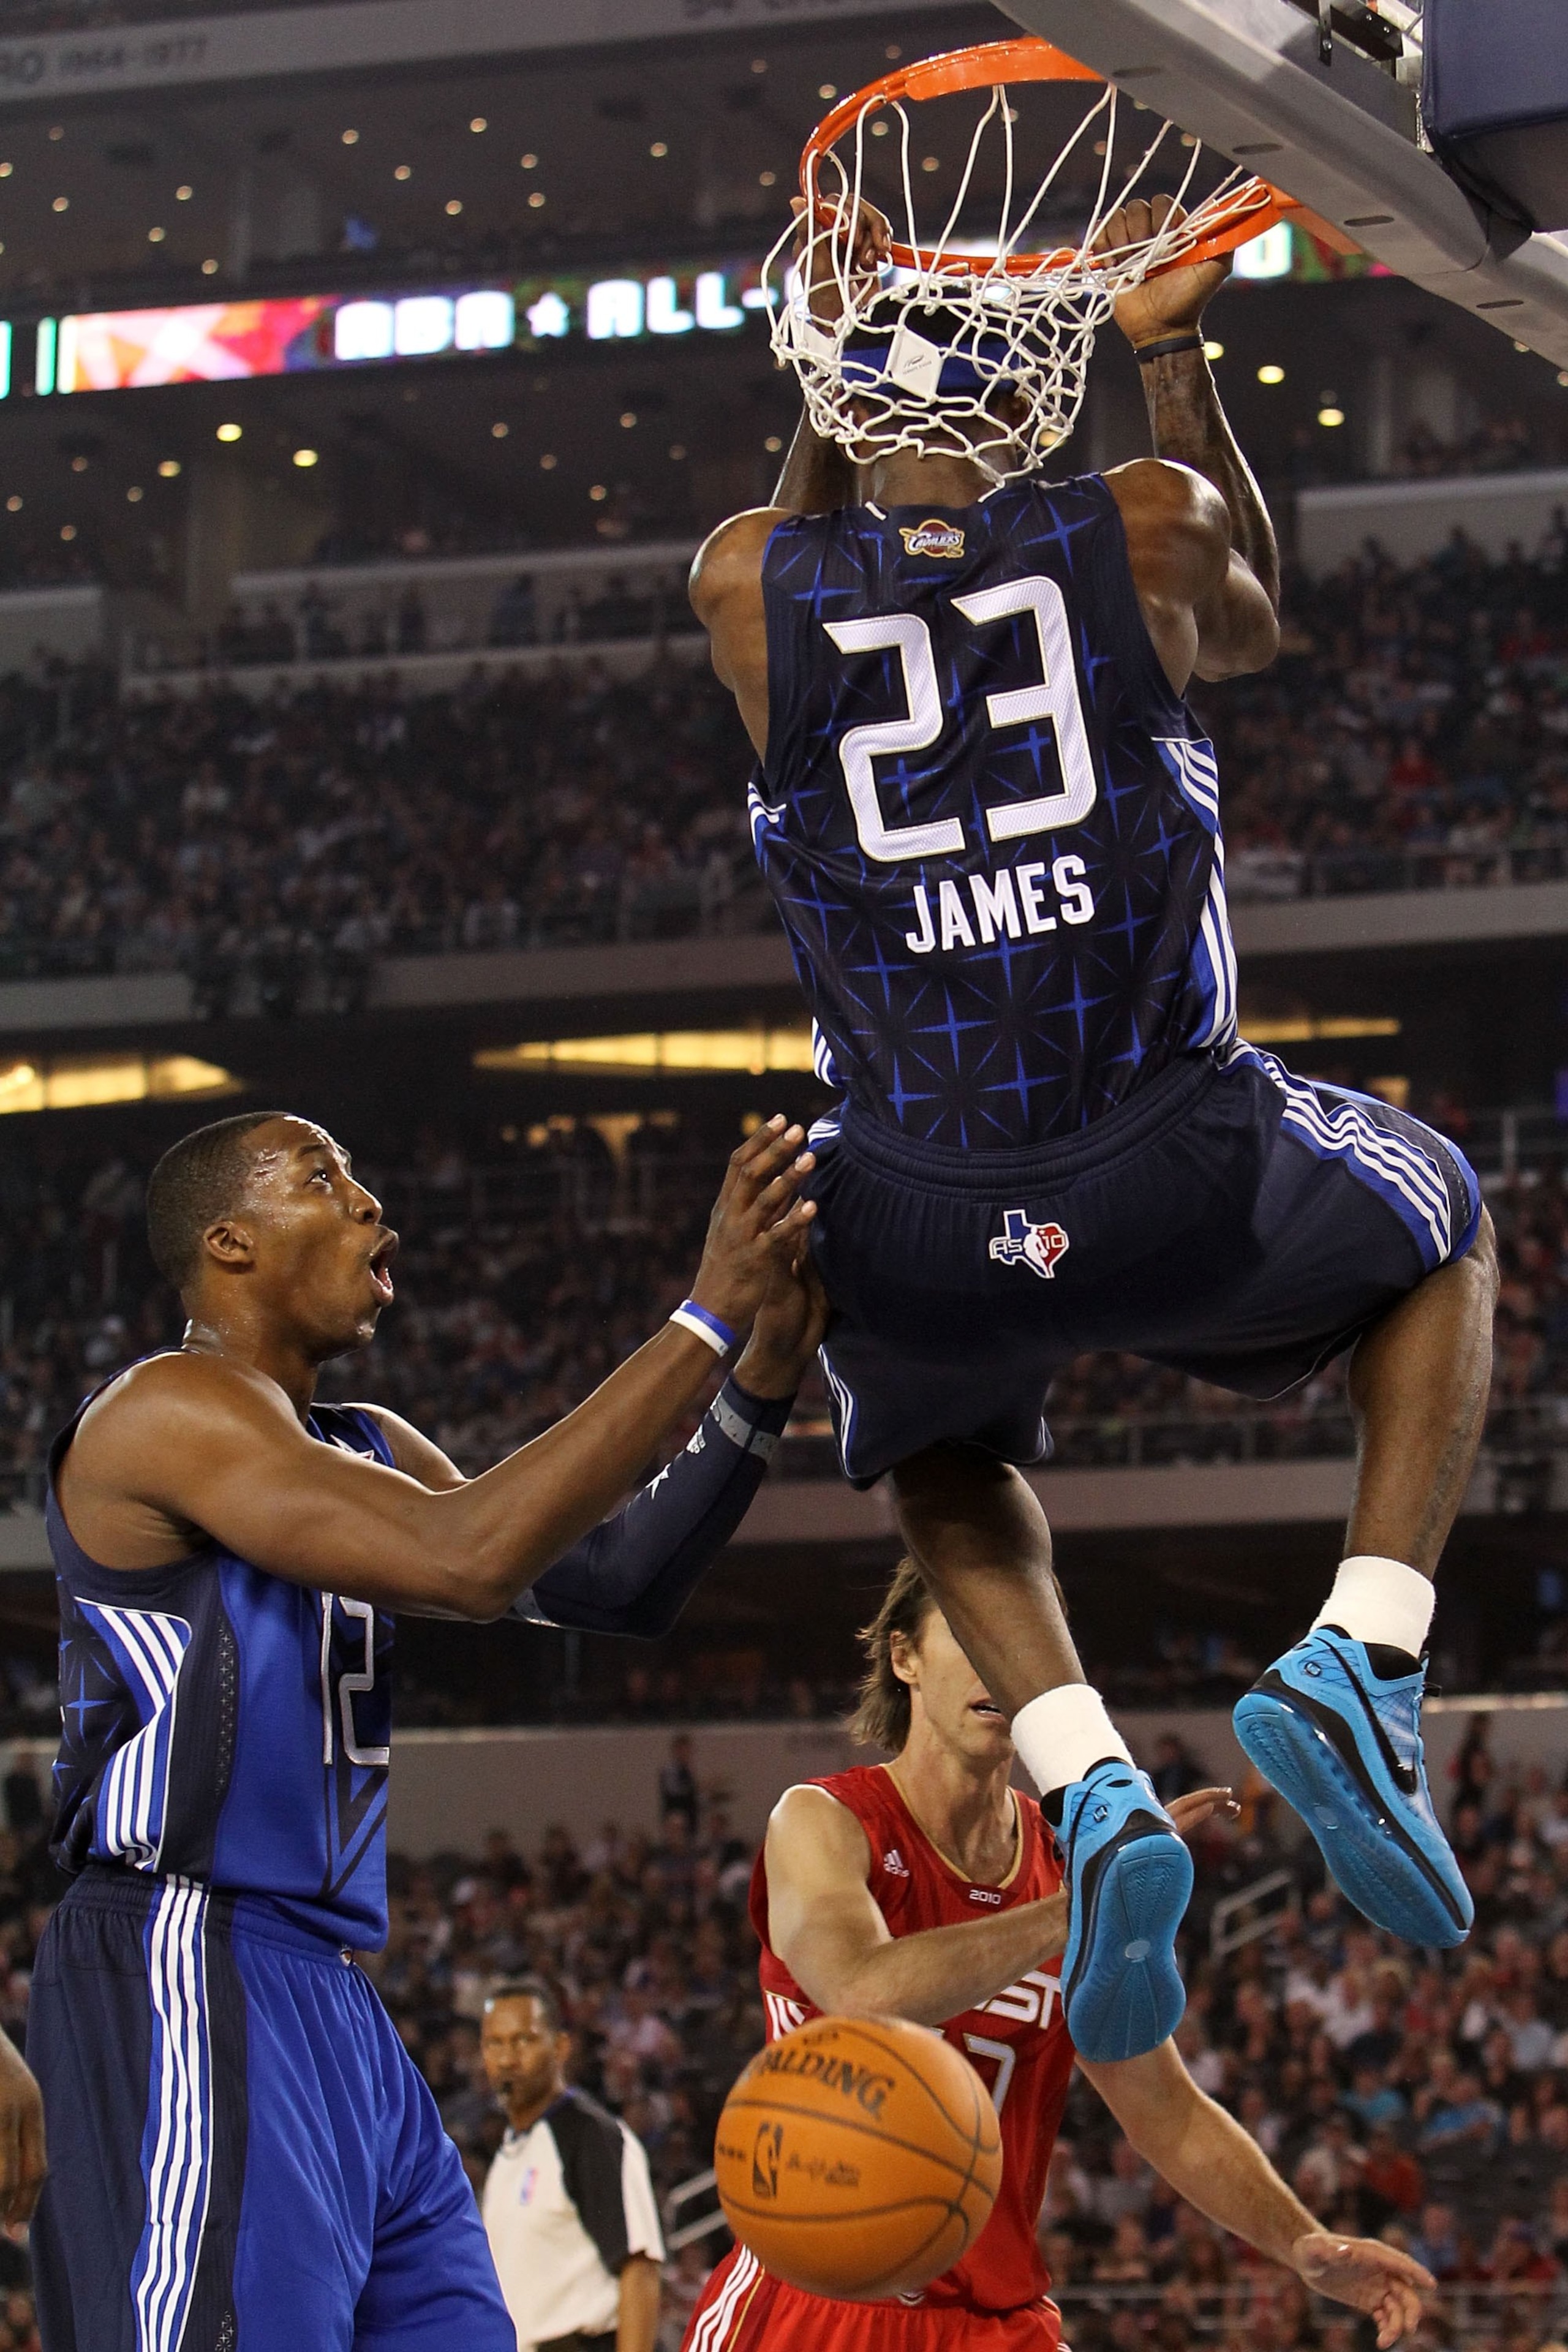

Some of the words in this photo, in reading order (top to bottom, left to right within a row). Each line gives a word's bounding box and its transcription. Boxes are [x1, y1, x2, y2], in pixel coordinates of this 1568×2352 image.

[335, 290, 514, 361] NBA
[822, 575, 1097, 862] 23
[905, 854, 1095, 954] JAMES
[321, 1591, 390, 1766] 12
[969, 1889, 1001, 1905] 2010
